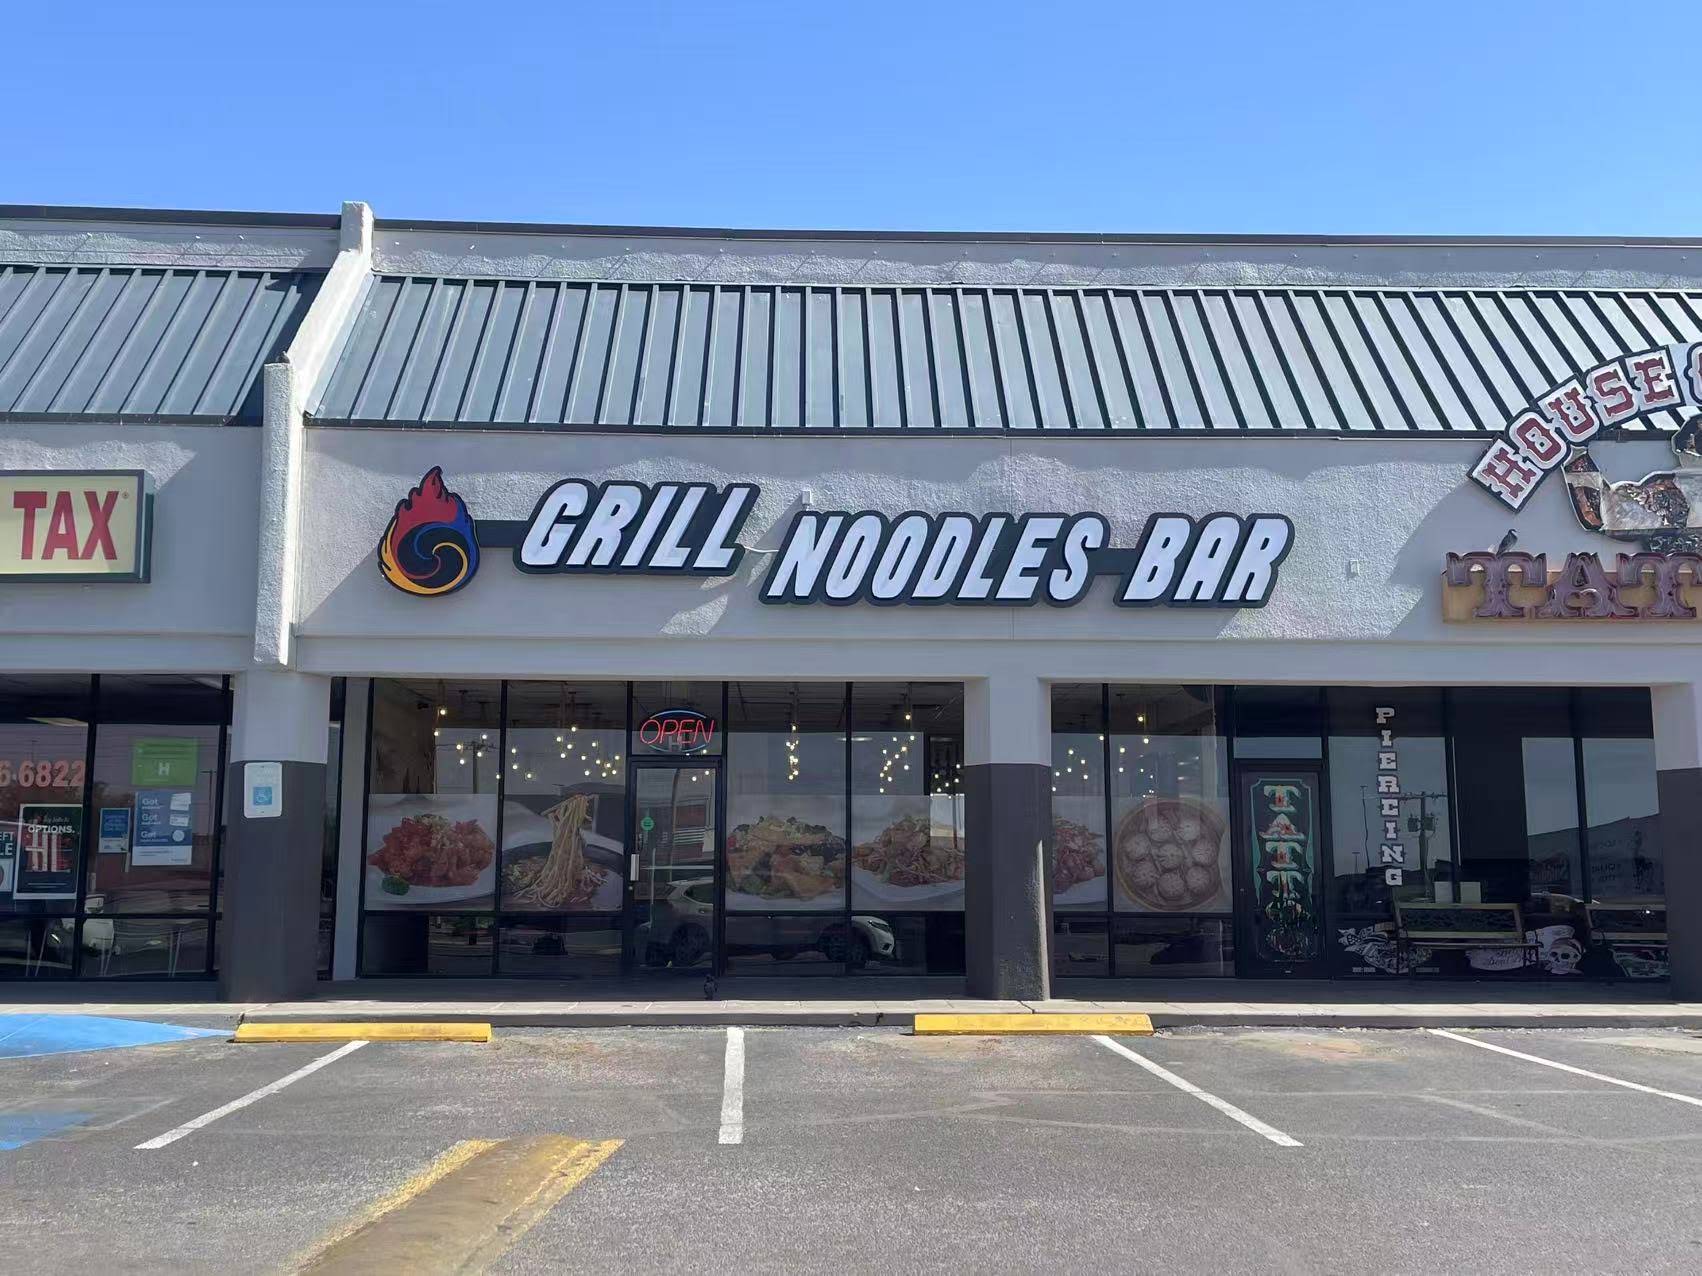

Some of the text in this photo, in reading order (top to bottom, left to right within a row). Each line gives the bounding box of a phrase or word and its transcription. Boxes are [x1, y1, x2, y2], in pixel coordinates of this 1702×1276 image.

[1480, 354, 1677, 500] HOUSE
[13, 490, 120, 560] TAX
[520, 483, 752, 569] GRILL
[766, 515, 1289, 601] NOODLES BAR
[640, 719, 715, 745] OPEN
[1376, 706, 1404, 887] PIERCING
